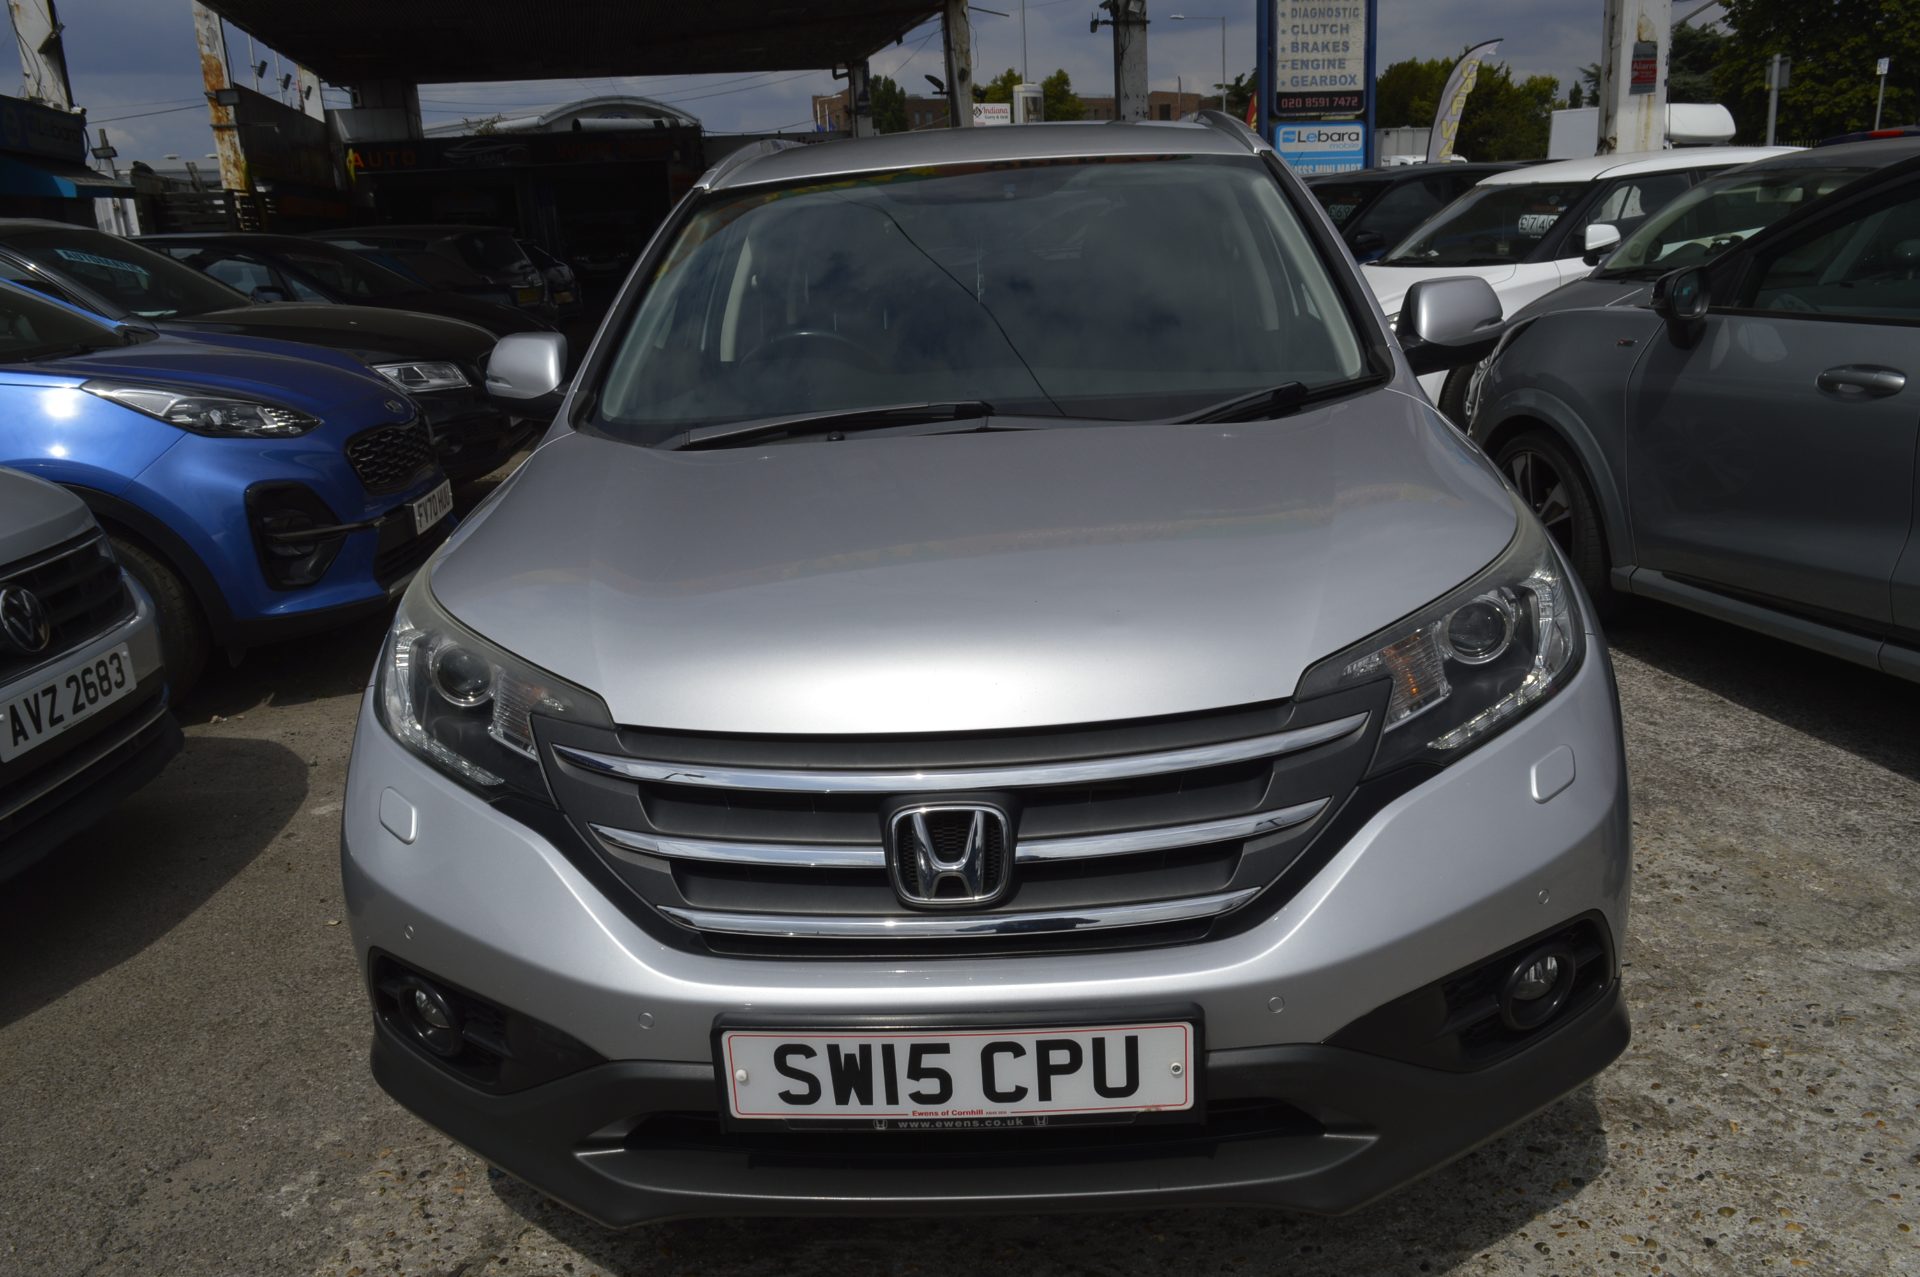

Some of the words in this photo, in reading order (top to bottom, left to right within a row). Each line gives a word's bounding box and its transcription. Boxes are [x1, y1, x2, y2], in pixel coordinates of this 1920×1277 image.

[1291, 7, 1360, 18] DIAGNOSTIC
[1291, 24, 1349, 36] CLUTCH
[1291, 41, 1350, 53] BRAKES
[1291, 58, 1346, 70] ENGINE
[1291, 74, 1357, 87] GEARBOX
[1281, 99, 1300, 108] 020
[1333, 97, 1358, 106] 7472
[1298, 130, 1360, 143] Lebara
[352, 150, 416, 168] AUTO
[9, 684, 65, 747] AVZ
[66, 652, 126, 716] 2683
[773, 1042, 955, 1107] SW15
[980, 1035, 1141, 1103] CPU
[898, 1116, 1024, 1129] www.ewens.co.uk
